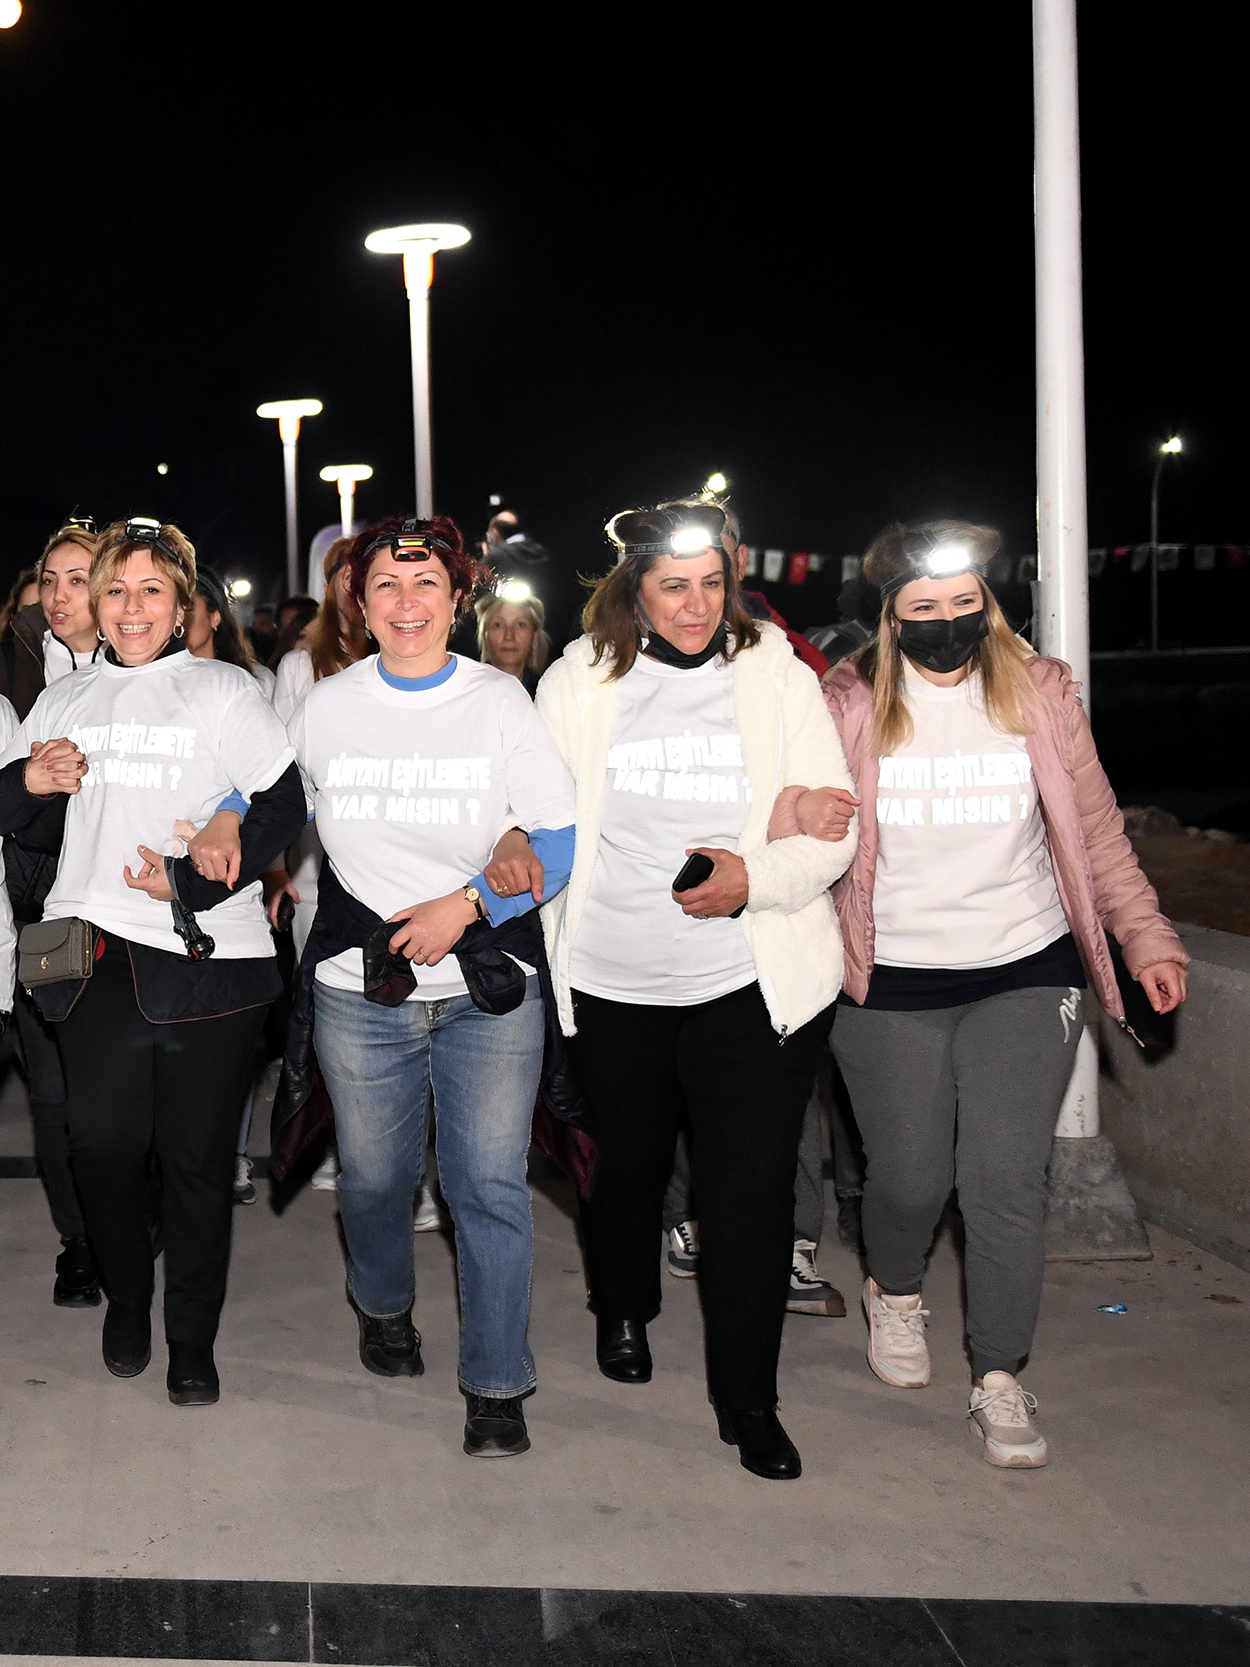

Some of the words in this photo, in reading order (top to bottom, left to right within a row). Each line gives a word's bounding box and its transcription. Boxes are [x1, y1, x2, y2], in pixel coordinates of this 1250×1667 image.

[168, 765, 182, 791] ?
[331, 795, 378, 820] VAR
[384, 796, 459, 825] MISIN
[466, 798, 481, 826] ?
[876, 798, 924, 826] VAR
[932, 795, 1011, 825] MISIN
